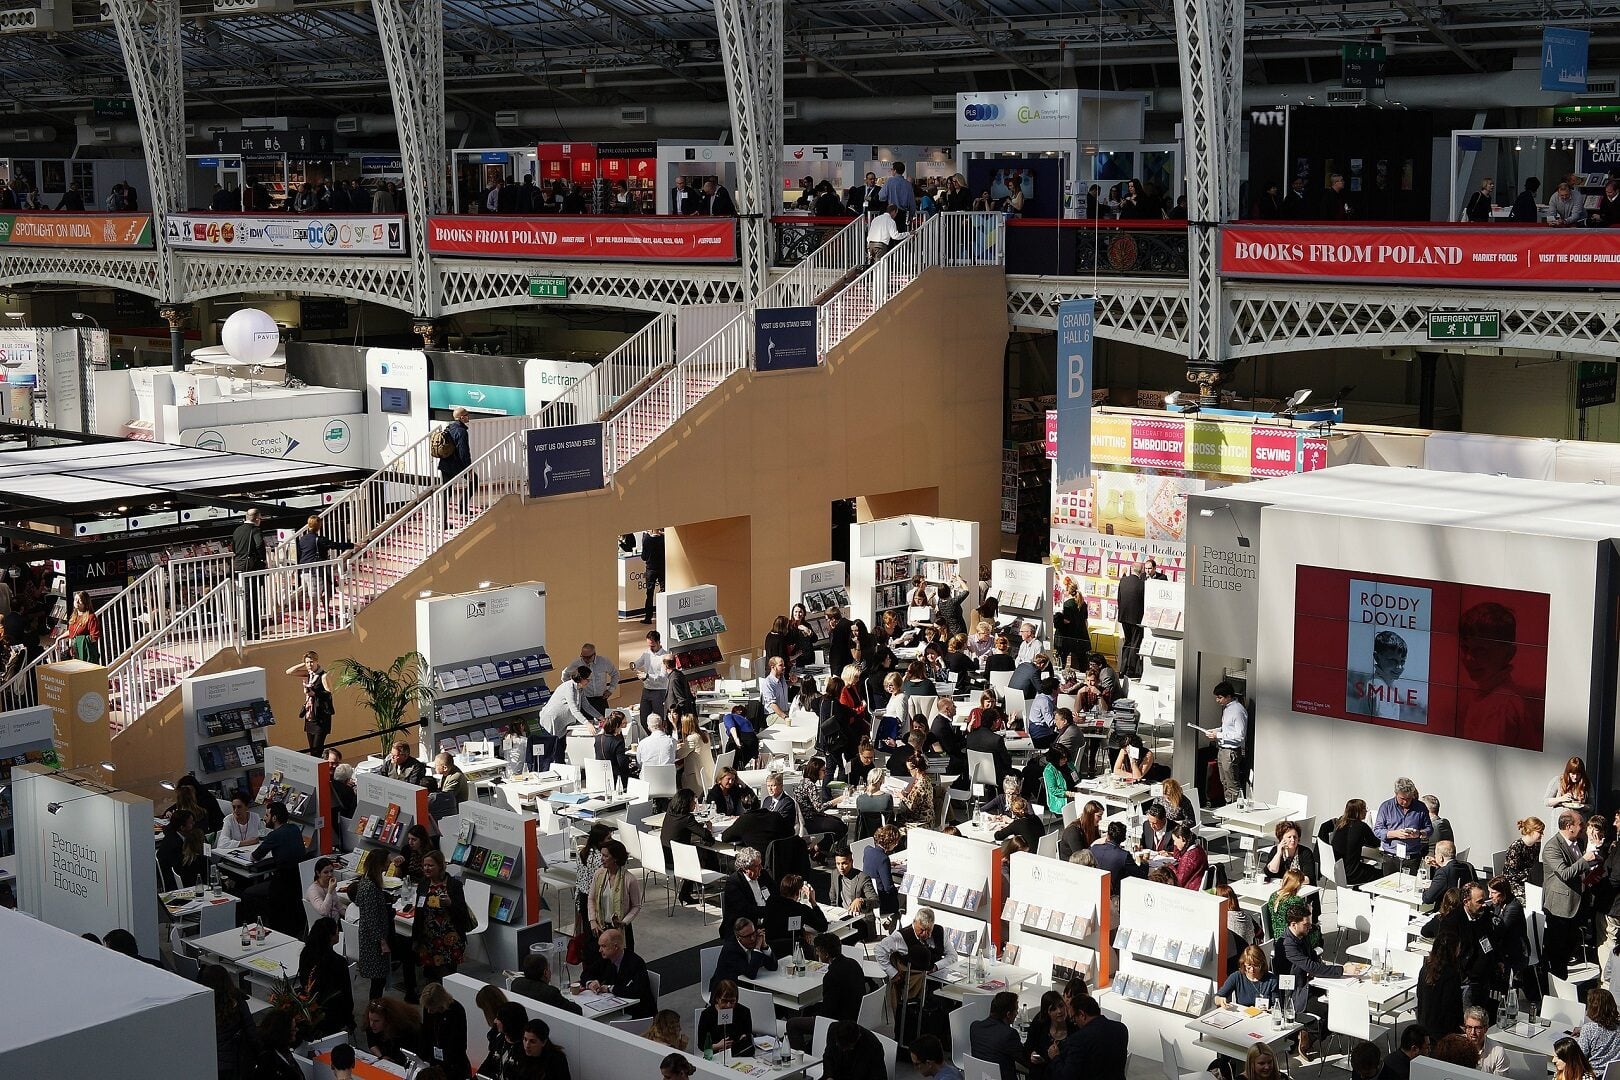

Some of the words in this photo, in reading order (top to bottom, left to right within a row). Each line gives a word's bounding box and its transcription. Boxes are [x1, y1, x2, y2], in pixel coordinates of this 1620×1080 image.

[1545, 45, 1554, 68] A
[1251, 111, 1285, 127] TATE
[241, 138, 254, 150] Lift
[15, 222, 54, 237] SPOTLIGHT
[55, 224, 68, 237] ON
[69, 224, 91, 238] INDIA
[308, 226, 323, 243] DC
[435, 227, 472, 242] BOOKS
[475, 229, 509, 244] FROM
[512, 230, 557, 245] POLAND
[1235, 242, 1303, 261] BOOKS
[1309, 244, 1372, 263] FROM
[1378, 245, 1463, 265] POLAND
[1472, 253, 1497, 262] MARKET
[1498, 253, 1517, 262] FOCUS
[1538, 254, 1555, 263] VISIT
[1556, 254, 1569, 263] THE
[1569, 254, 1592, 263] POLISH
[786, 320, 799, 328] STAND
[1062, 313, 1090, 328] GRAND
[1431, 314, 1478, 323] EMERGENCY
[1479, 314, 1496, 322] EXIT
[1063, 330, 1082, 344] HALL
[1084, 329, 1089, 342] 6
[0, 349, 32, 360] SHIFT
[541, 371, 578, 386] Bertram
[1068, 354, 1084, 398] B
[1091, 435, 1126, 449] KNITTING
[1164, 430, 1183, 438] BOOKS
[251, 438, 282, 447] Connect
[260, 446, 282, 455] Books
[534, 443, 547, 452] VISIT
[556, 442, 564, 450] ON
[565, 440, 582, 449] STAND
[1133, 438, 1183, 453] EMBROIDERY
[1187, 442, 1216, 456] CROSS
[1217, 444, 1247, 458] STITCH
[1256, 448, 1290, 462] SEWING
[1057, 533, 1086, 546] Welcome
[1089, 537, 1097, 547] to
[1100, 538, 1111, 548] the
[1115, 540, 1137, 551] World
[1140, 543, 1148, 554] of
[1202, 546, 1256, 565] Penguin
[1202, 560, 1256, 579] Random
[1202, 574, 1242, 591] House
[1360, 592, 1420, 612] RODDY
[1362, 610, 1416, 630] DOYLE
[40, 674, 55, 683] GRAND
[54, 677, 66, 686] HALL
[44, 684, 63, 693] GALLERY
[46, 692, 57, 700] HALL
[1355, 681, 1418, 707] SMILE
[51, 832, 98, 863] Penguin
[52, 852, 99, 883] Random
[53, 871, 88, 898] House
